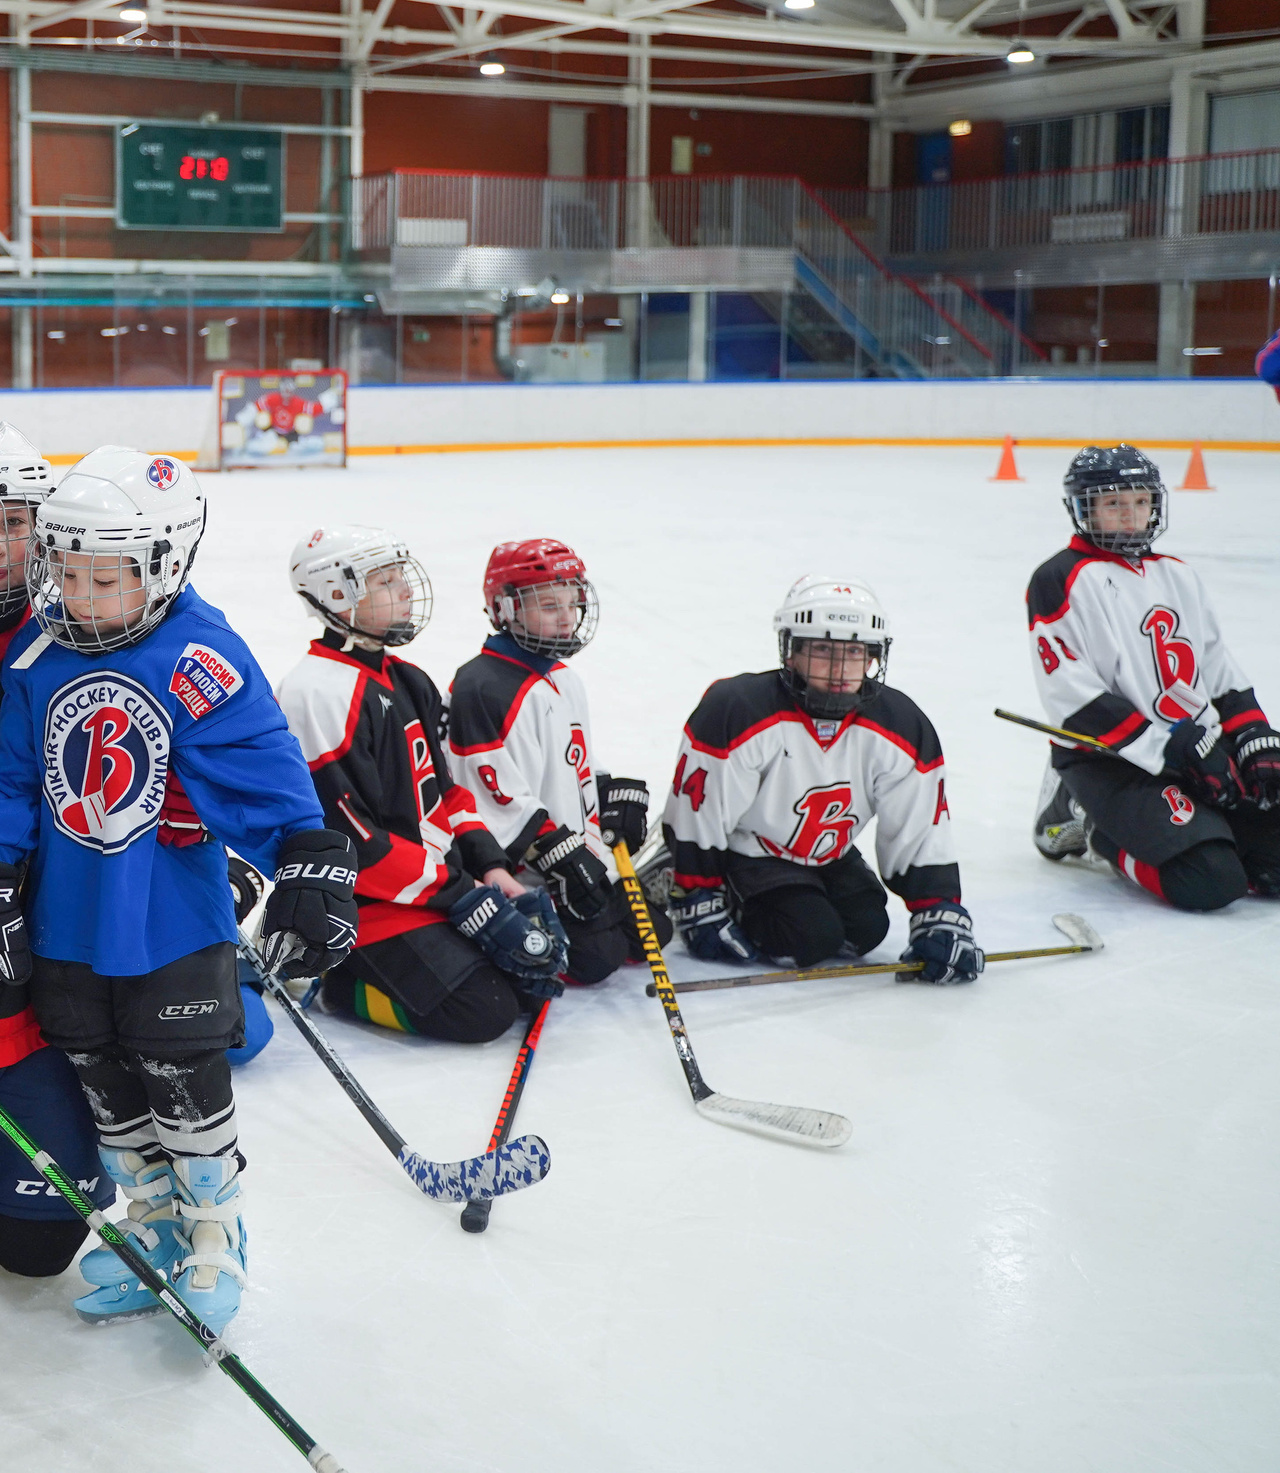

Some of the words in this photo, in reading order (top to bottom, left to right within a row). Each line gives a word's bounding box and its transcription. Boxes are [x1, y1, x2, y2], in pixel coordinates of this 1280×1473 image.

[44, 521, 86, 536] BAUER
[176, 516, 202, 531] BAUER
[828, 613, 859, 623] CCM
[190, 668, 223, 704] МОЁМ
[191, 649, 236, 690] РОССИЯ
[53, 686, 120, 732] HOCKEY
[123, 697, 163, 743] CLUB
[179, 679, 210, 716] ЕРДЦЕ
[47, 743, 68, 805] VIKHR
[139, 753, 168, 815] VIKHR
[274, 863, 358, 887] BAUER
[458, 897, 499, 937] RIOR
[623, 876, 677, 1003] FRONTIER
[164, 1002, 218, 1016] CCM
